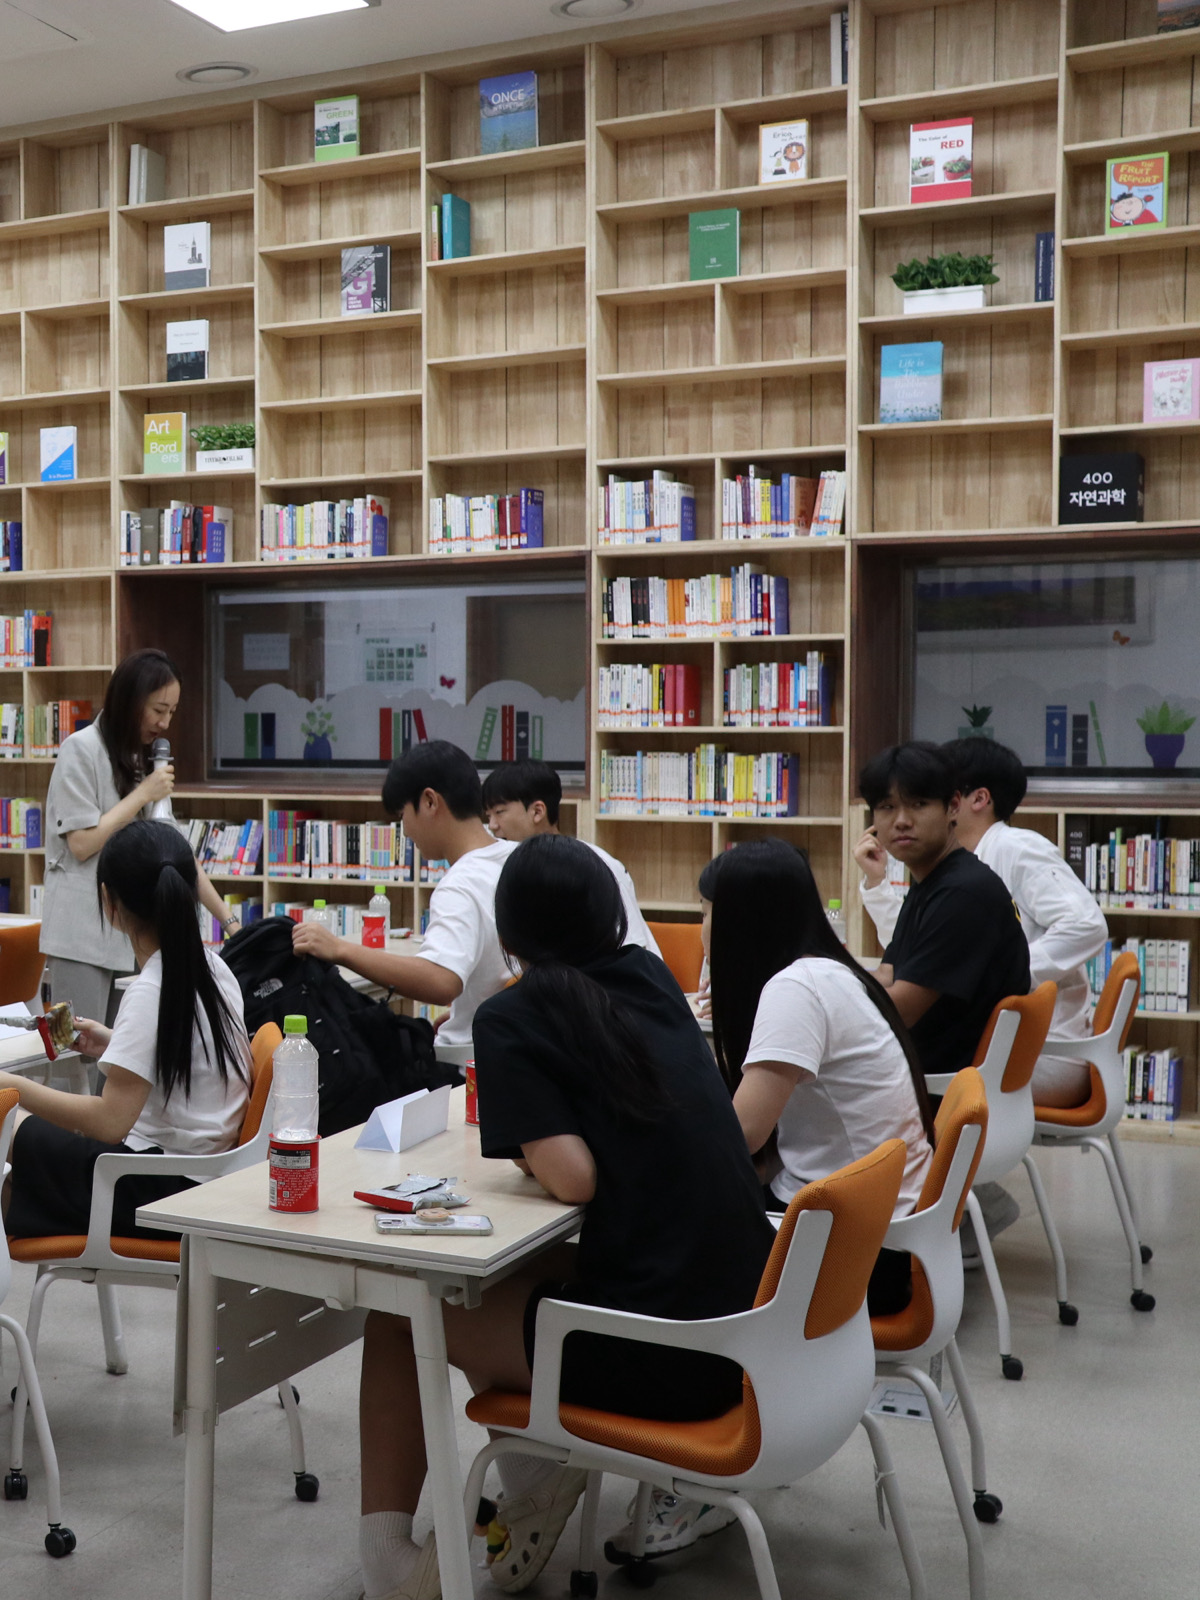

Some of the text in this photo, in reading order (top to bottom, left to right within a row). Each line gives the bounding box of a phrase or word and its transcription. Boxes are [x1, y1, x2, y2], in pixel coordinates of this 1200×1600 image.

[491, 89, 525, 105] ONCE
[326, 109, 354, 120] GREEN
[940, 139, 965, 149] RED
[1120, 164, 1152, 175] FRUIT
[1118, 173, 1160, 184] REPORT
[146, 419, 170, 436] Art
[150, 441, 177, 454] Bord
[161, 454, 180, 464] ers
[1082, 471, 1113, 485] 400
[1069, 488, 1127, 507] 자연과학
